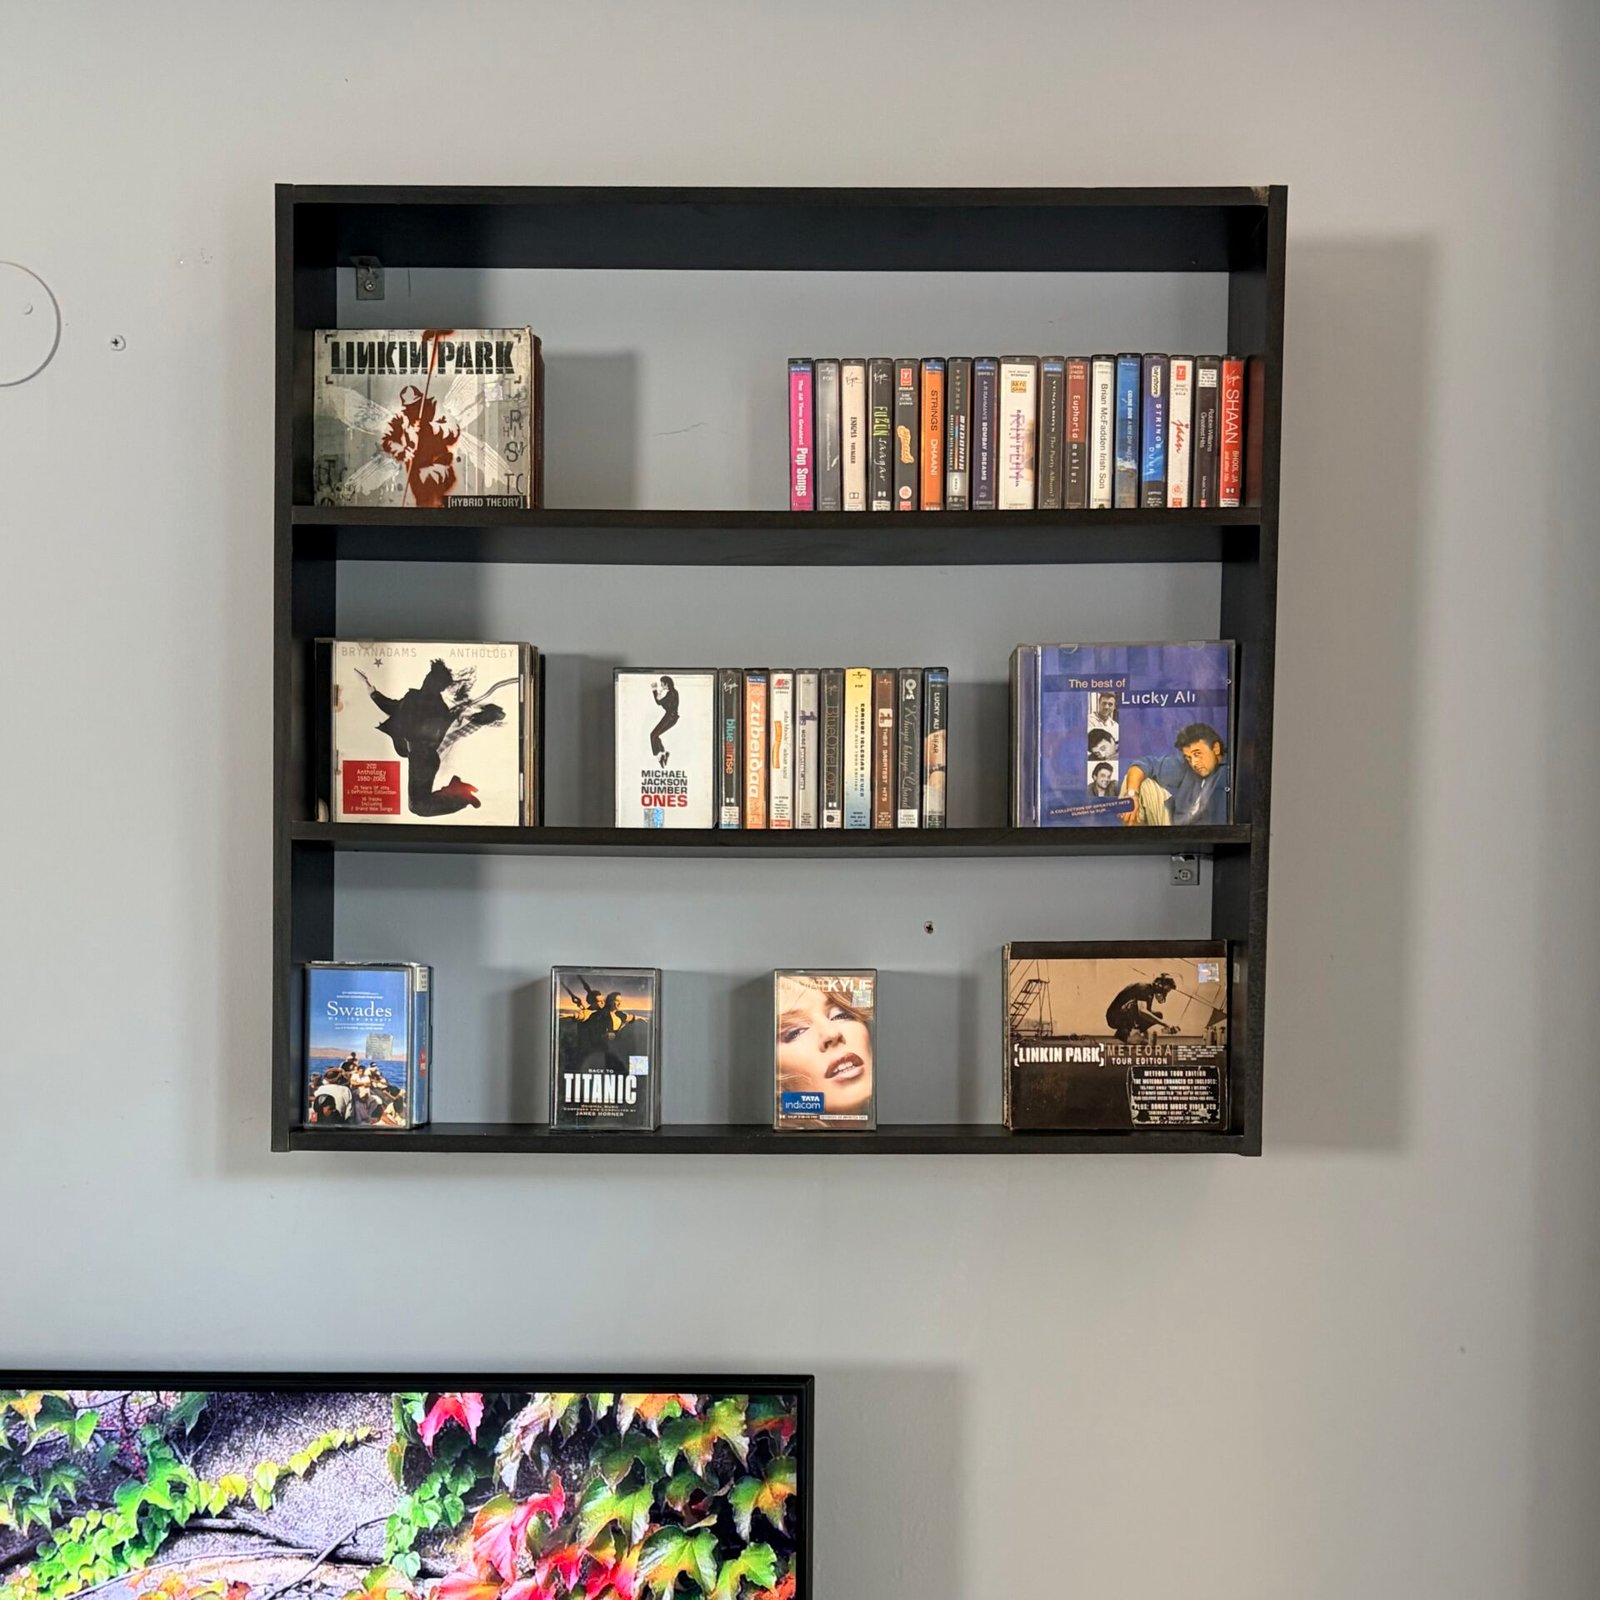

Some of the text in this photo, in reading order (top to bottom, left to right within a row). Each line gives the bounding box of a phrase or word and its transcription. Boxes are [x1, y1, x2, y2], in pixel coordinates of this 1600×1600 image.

[331, 341, 514, 374] LINKIN PARK
[1072, 395, 1081, 439] Euphoria
[1225, 389, 1240, 443] SHAAN
[930, 390, 938, 476] STRINGS DHAANI
[1099, 407, 1108, 451] McFadden
[1171, 419, 1190, 455] jaan
[958, 415, 966, 470] MADONNA
[1099, 453, 1107, 471] Irish
[795, 447, 808, 497] Pop Songs
[1231, 474, 1239, 483] JA
[1098, 473, 1107, 492] Son
[449, 648, 514, 658] ANTHOLOGY
[1068, 677, 1126, 688] The best of
[1121, 690, 1196, 707] Lucky Ali
[932, 734, 940, 753] SIFAR
[641, 770, 688, 778] MICHAEL
[641, 778, 688, 786] JACKSON
[641, 786, 688, 794] NUMBER
[640, 794, 688, 807] ONES
[1055, 806, 1084, 814] COLLECTION
[828, 979, 872, 992] KYLIE
[327, 1000, 392, 1018] Swades
[1107, 1044, 1172, 1057] METEORA
[1112, 1057, 1168, 1065] TOUR EDITION
[563, 1073, 637, 1105] TITANIC
[785, 1100, 821, 1110] indicom
